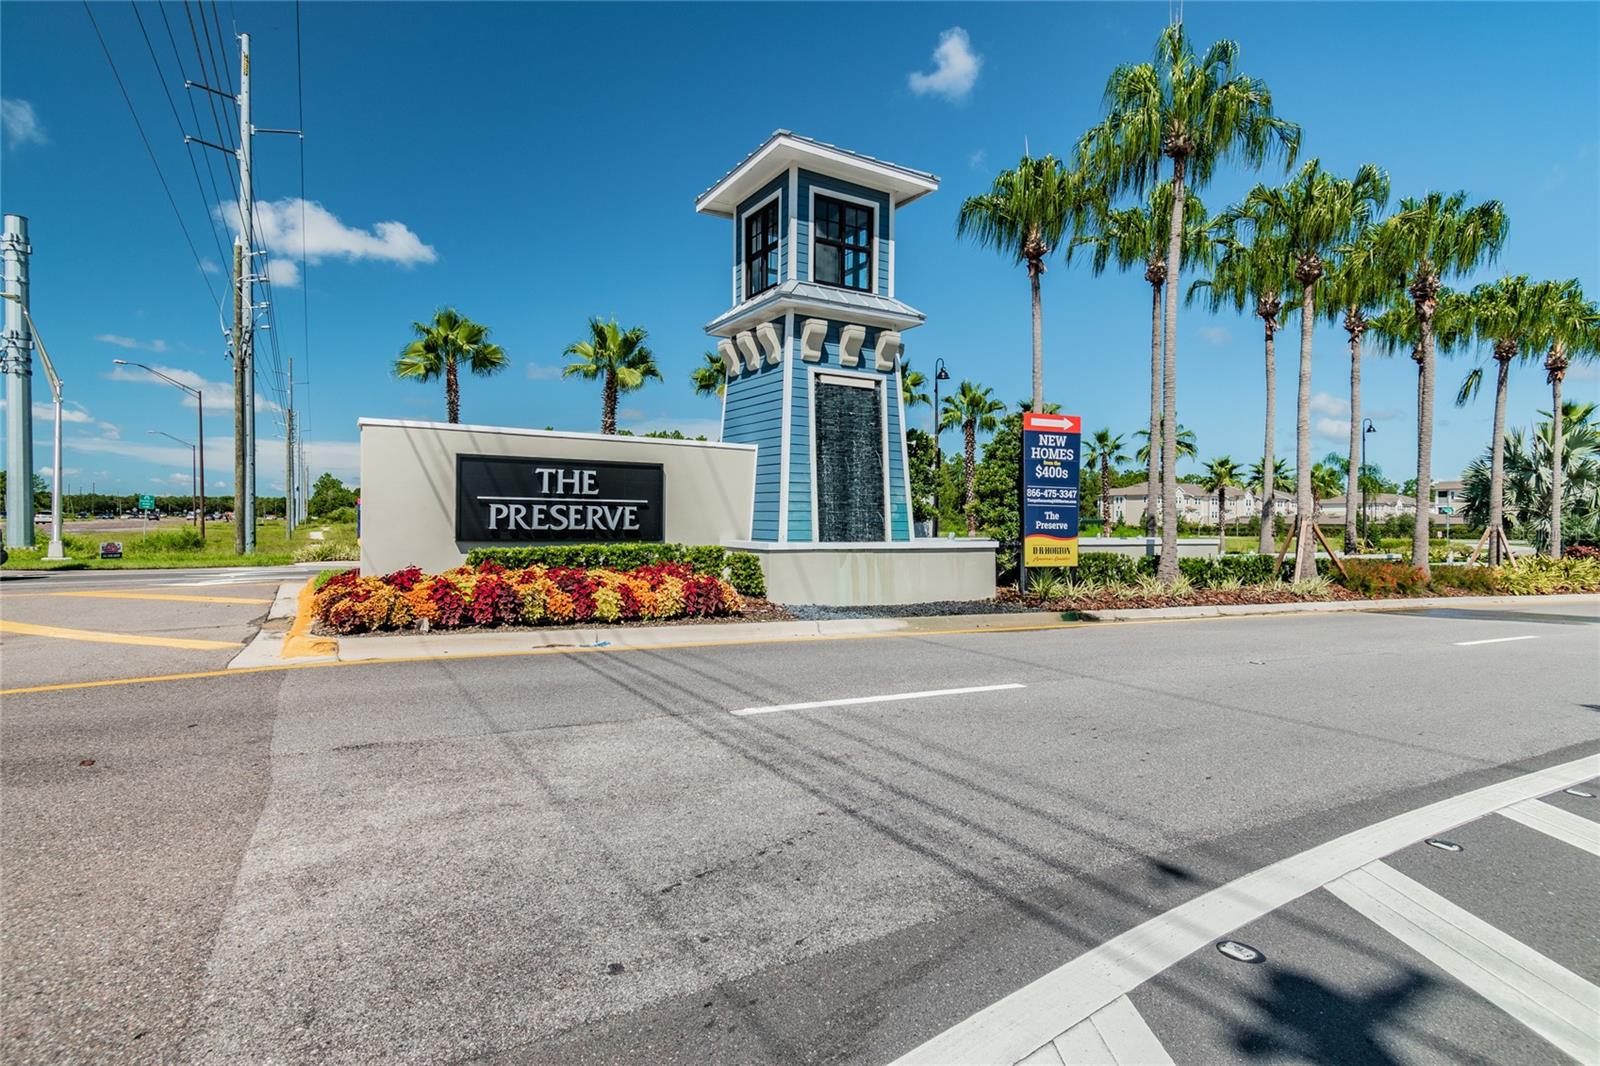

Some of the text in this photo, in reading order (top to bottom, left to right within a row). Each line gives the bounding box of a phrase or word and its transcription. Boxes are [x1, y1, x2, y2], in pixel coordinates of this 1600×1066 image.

[1038, 434, 1067, 447] NEW
[1031, 447, 1074, 461] HOMES
[1035, 464, 1069, 479] $400s
[535, 468, 599, 495] THE
[1027, 489, 1077, 498] 866-475-3347
[488, 503, 640, 531] PRESERVE
[1044, 511, 1060, 521] The
[1035, 520, 1068, 530] Preserve
